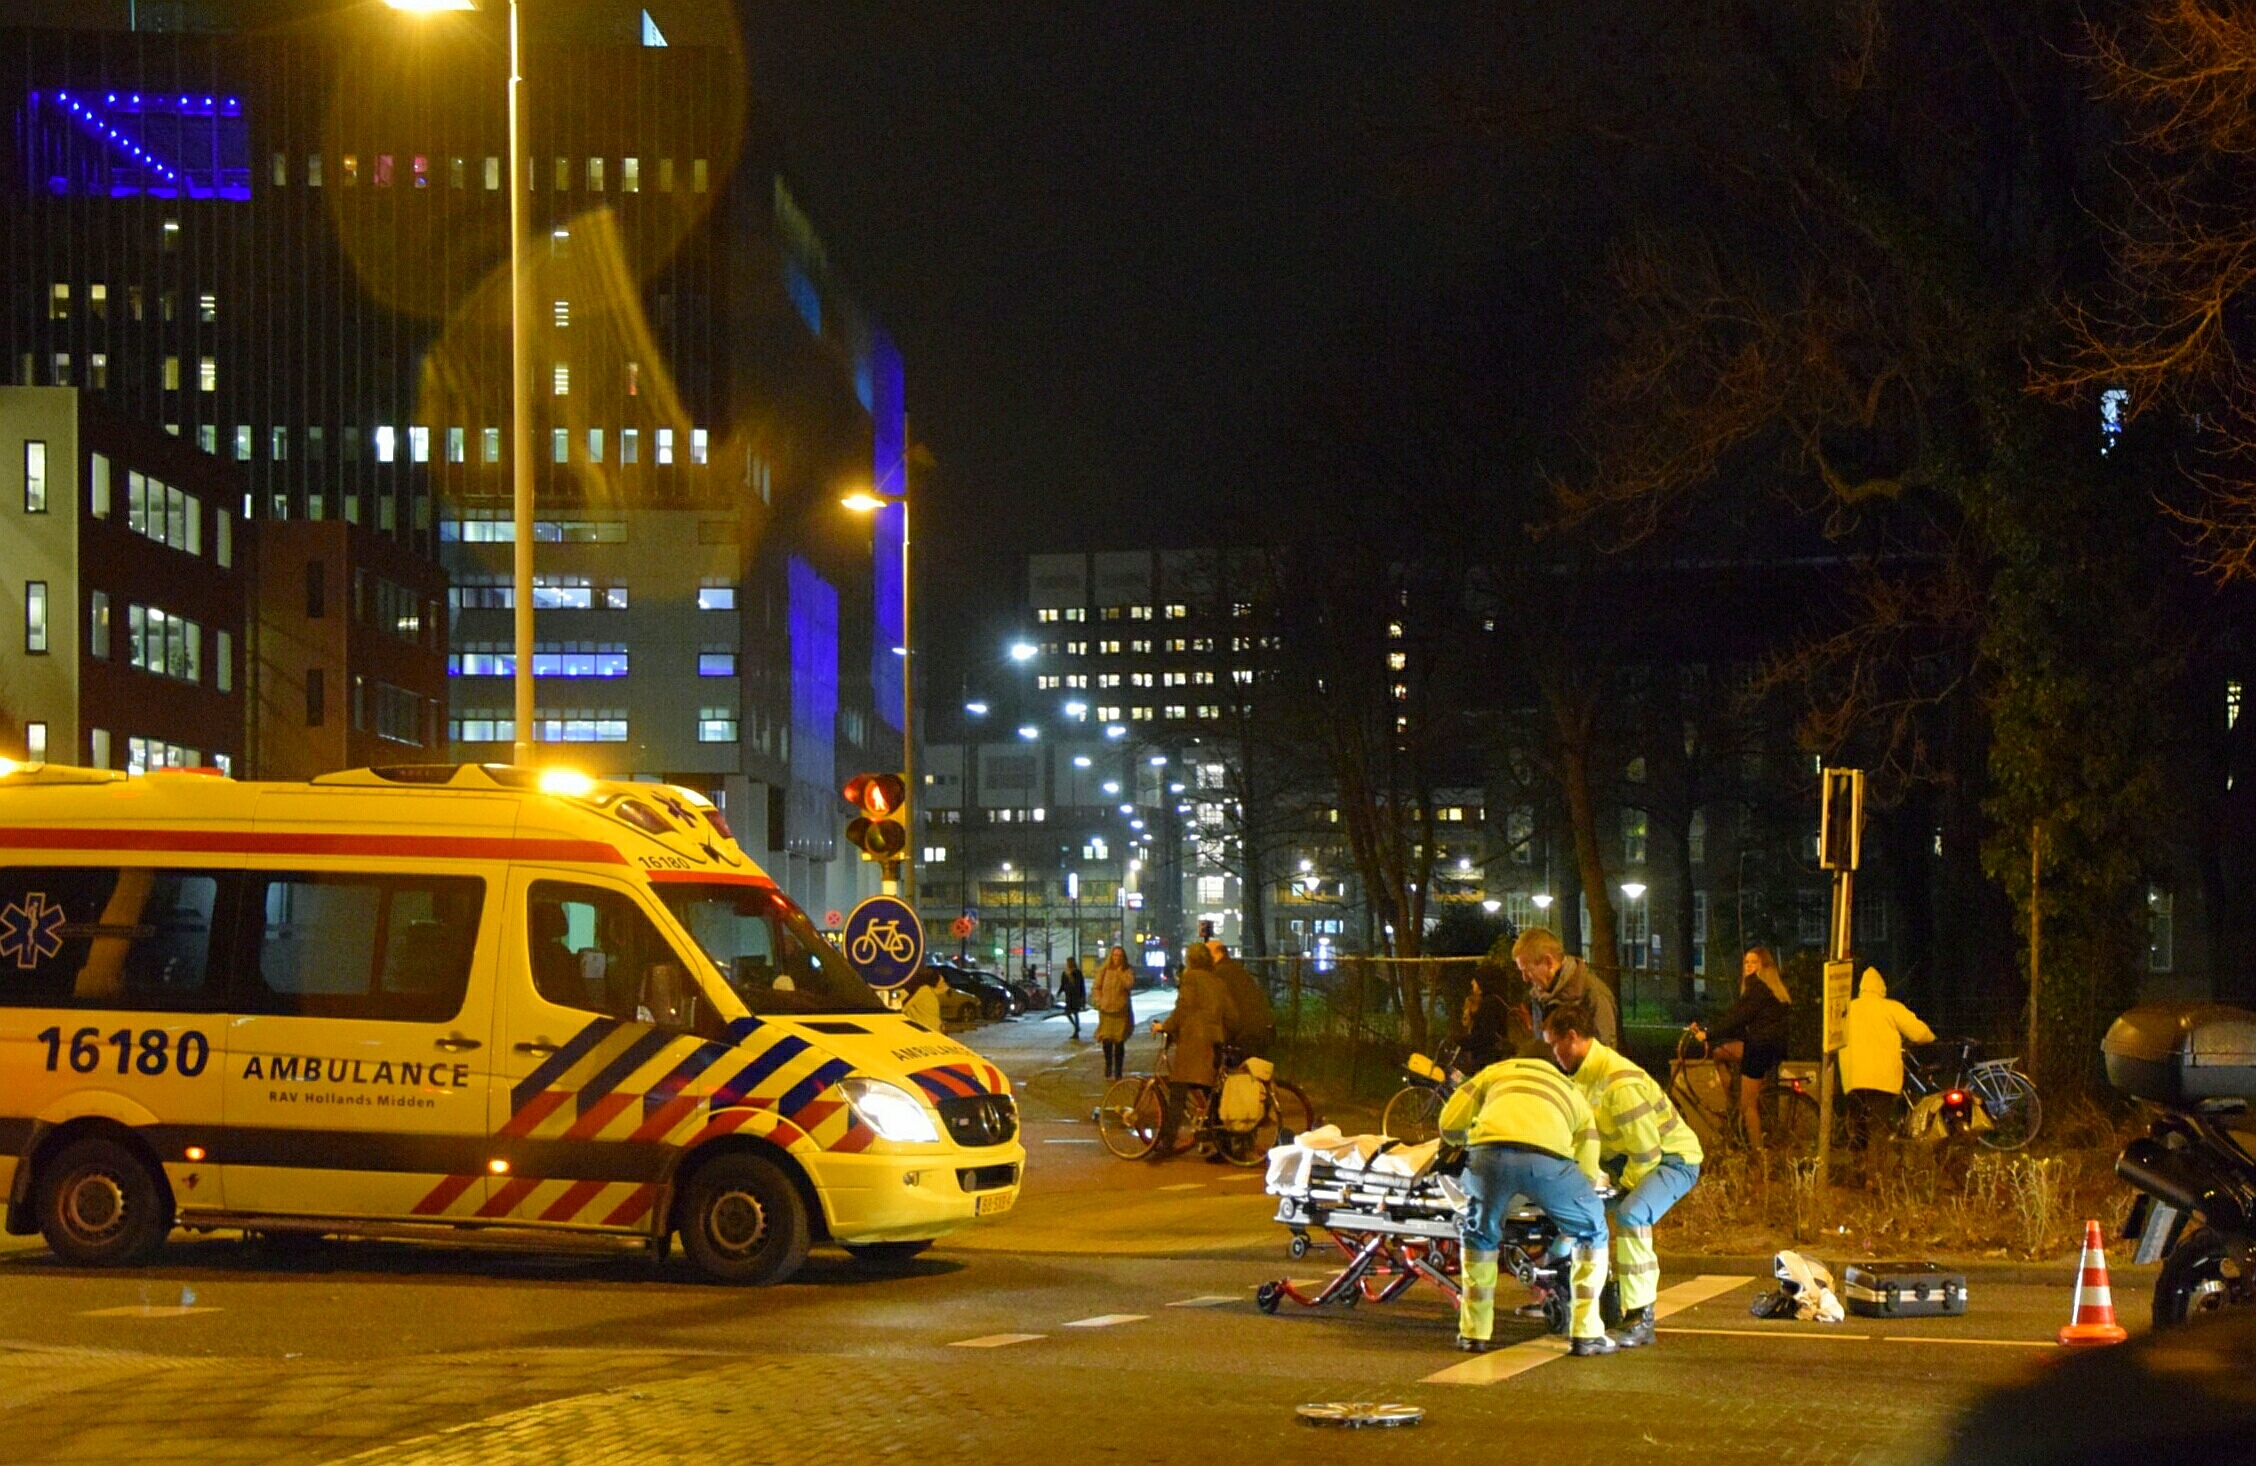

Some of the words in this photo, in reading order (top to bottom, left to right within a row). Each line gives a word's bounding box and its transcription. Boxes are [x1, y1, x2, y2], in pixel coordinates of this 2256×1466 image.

[638, 856, 691, 869] 16180
[38, 1027, 209, 1077] 16180
[242, 1056, 469, 1087] AMBULANCE
[268, 1091, 299, 1105] RAV
[305, 1093, 372, 1107] Hollands
[377, 1094, 435, 1108] Midden
